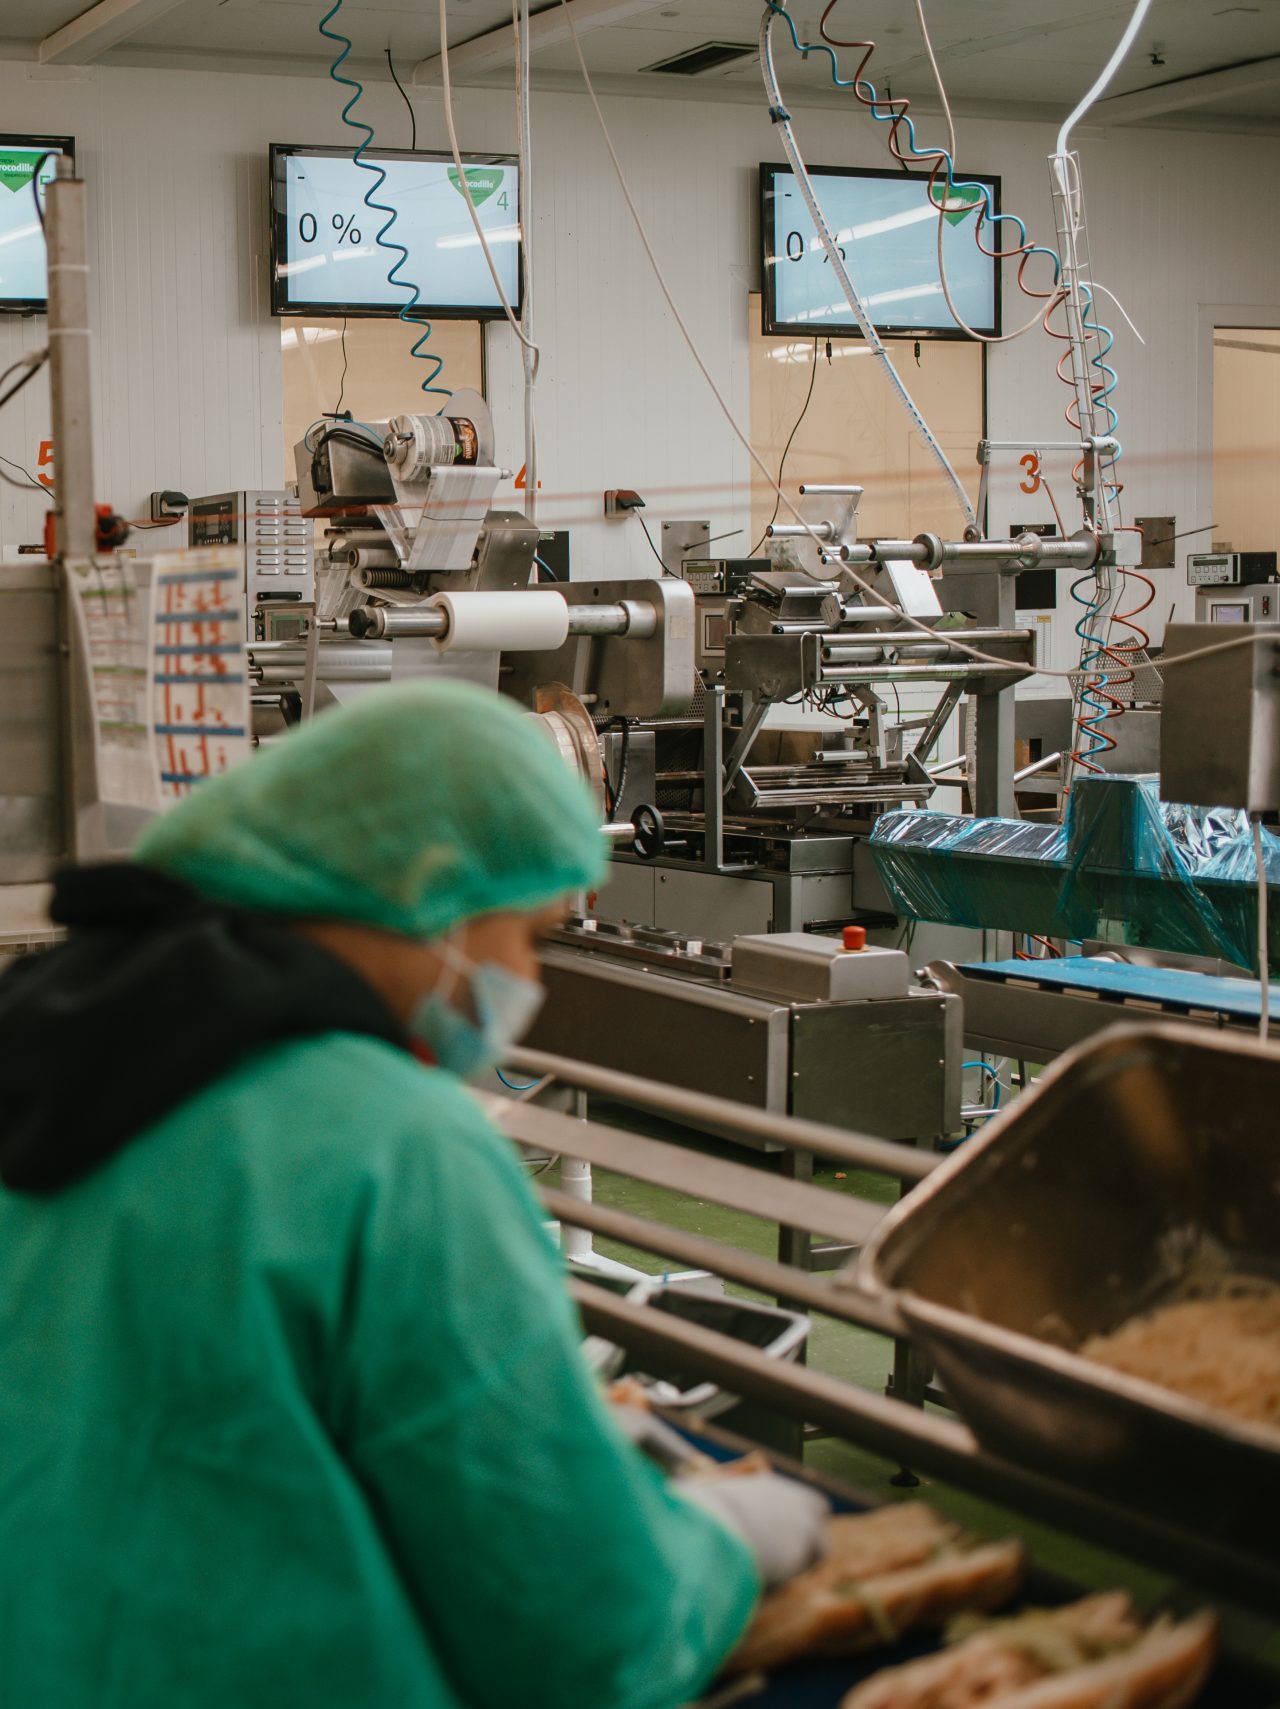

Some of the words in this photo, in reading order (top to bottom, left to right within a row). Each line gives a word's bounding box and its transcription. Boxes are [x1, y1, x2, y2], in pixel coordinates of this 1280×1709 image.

[496, 191, 510, 211] 4
[298, 212, 318, 243] 0
[331, 213, 362, 245] %
[786, 231, 804, 262] 0
[1019, 454, 1041, 494] 3
